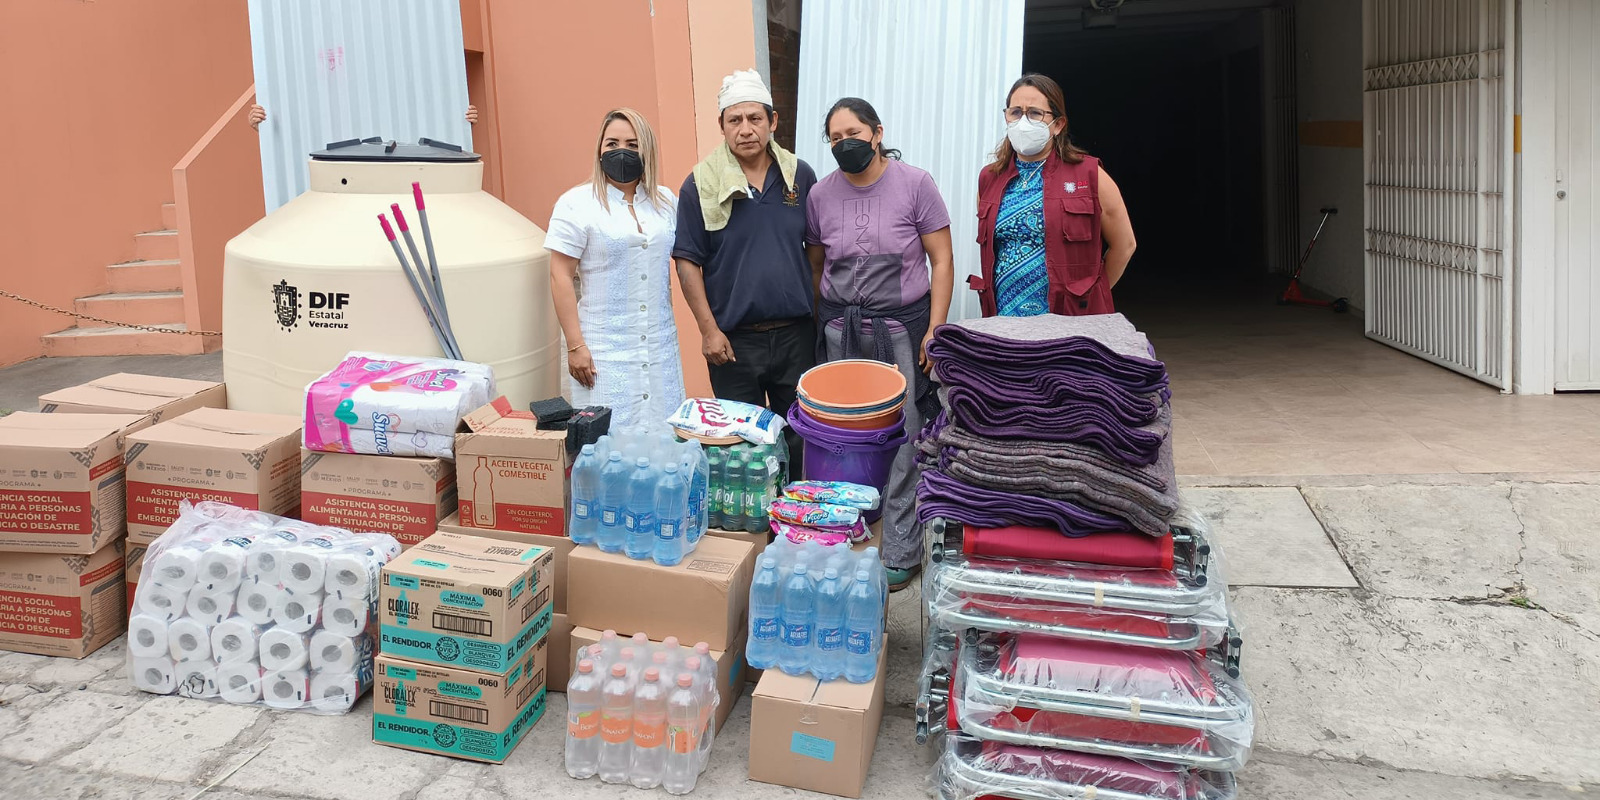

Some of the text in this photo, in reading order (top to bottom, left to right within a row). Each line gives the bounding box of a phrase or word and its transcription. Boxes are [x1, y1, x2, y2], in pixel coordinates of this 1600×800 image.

[309, 291, 350, 310] DIF
[309, 310, 344, 320] Estatal
[308, 320, 349, 329] Veracruz
[491, 460, 555, 471] ACEITE VEGETAL
[498, 469, 547, 480] COMESTIBLE
[172, 476, 212, 486] PROGRAMA
[150, 488, 235, 504] ASISTENCIA SOCIAL
[348, 487, 387, 497] PROGRAMA
[0, 494, 63, 503] NCIA SOCIAL
[0, 503, 17, 511] RIA
[29, 504, 82, 513] PERSONAS
[154, 507, 166, 515] EN
[325, 498, 411, 514] ASISTENCIA SOCIAL
[43, 513, 57, 521] DE
[309, 505, 369, 518] ALIMENTARIA
[379, 513, 427, 525] PERSONAS
[517, 509, 554, 518] COLESTEROL
[0, 521, 18, 529] CIA
[30, 522, 81, 532] DESASTRE
[329, 516, 405, 531] EN SITUACIÓN DE
[449, 592, 477, 602] MÁXIMA
[482, 587, 503, 597] 0060
[0, 595, 56, 607] NCIA SOCIAL
[442, 597, 483, 608] CONCENTRACIÓN
[25, 606, 72, 617] PERSONAS
[387, 598, 419, 616] CLORALEX
[38, 616, 51, 624] DE
[0, 621, 16, 629] CIA
[27, 624, 71, 636] DESASTRE
[382, 634, 390, 643] EL
[468, 650, 496, 659] BLANQUEA
[507, 646, 515, 661] EL
[445, 682, 473, 692] MÁXIMA
[477, 677, 499, 688] 0060
[384, 686, 416, 703] CLORALEX
[439, 686, 480, 697] CONCENTRACIÓN
[377, 721, 386, 729] EL
[464, 737, 492, 746] BLANQUEA
[503, 733, 512, 748] EL
